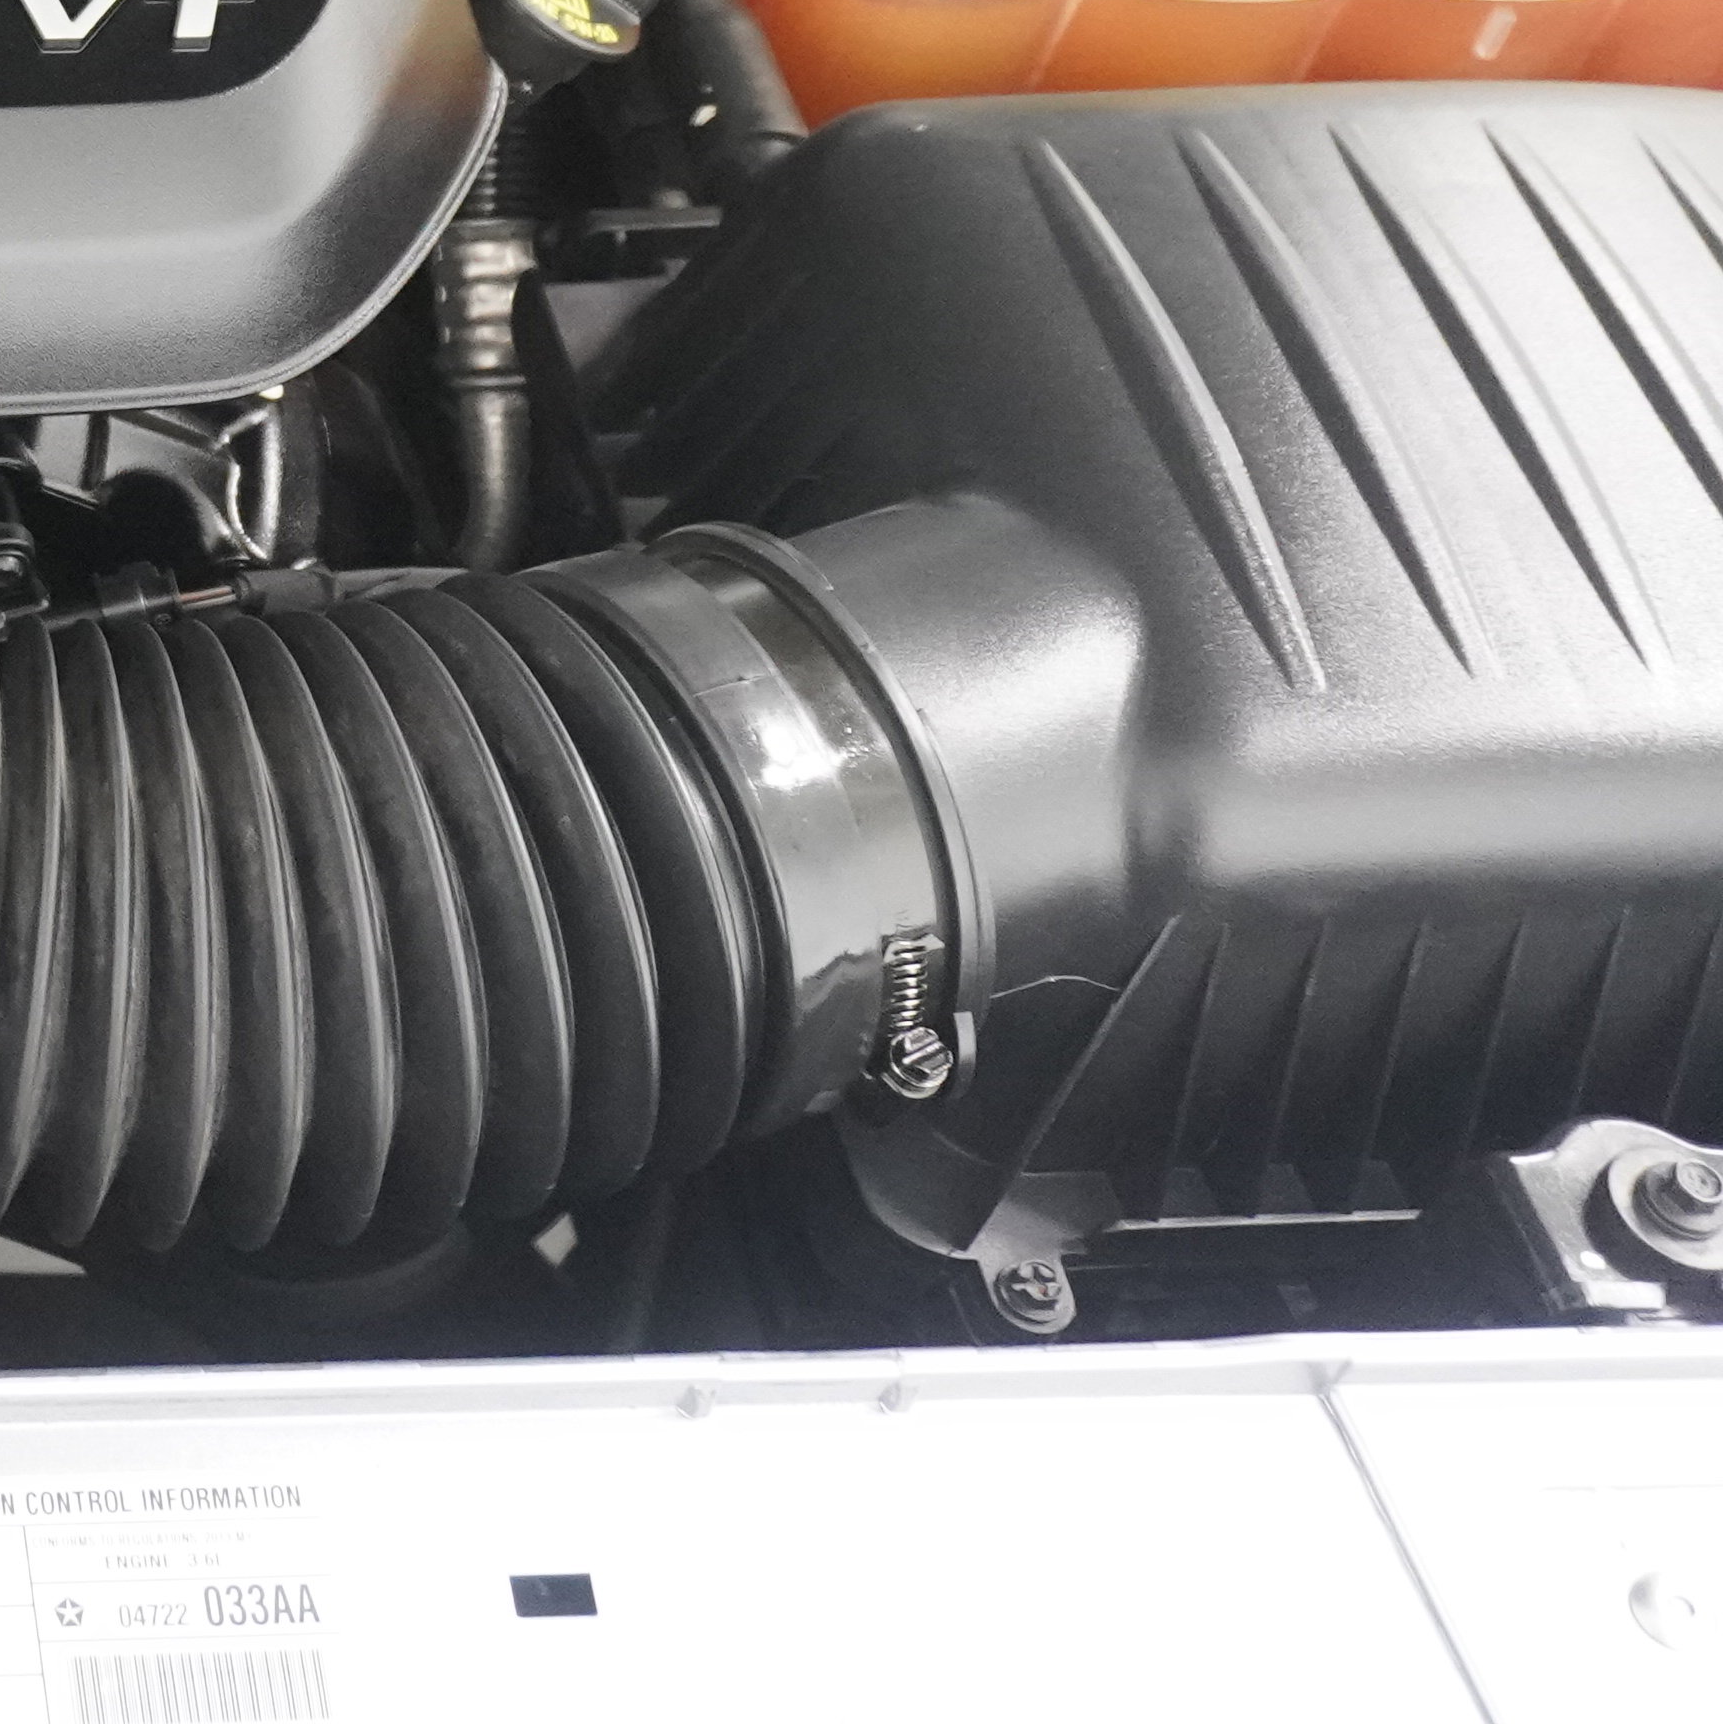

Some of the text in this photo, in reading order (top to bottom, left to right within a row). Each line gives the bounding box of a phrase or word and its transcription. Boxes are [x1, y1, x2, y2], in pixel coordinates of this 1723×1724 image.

[26, 1489, 131, 1515] CONTROL
[142, 1485, 301, 1511] INFORMATION
[119, 1584, 320, 1628] 04722 033AA
